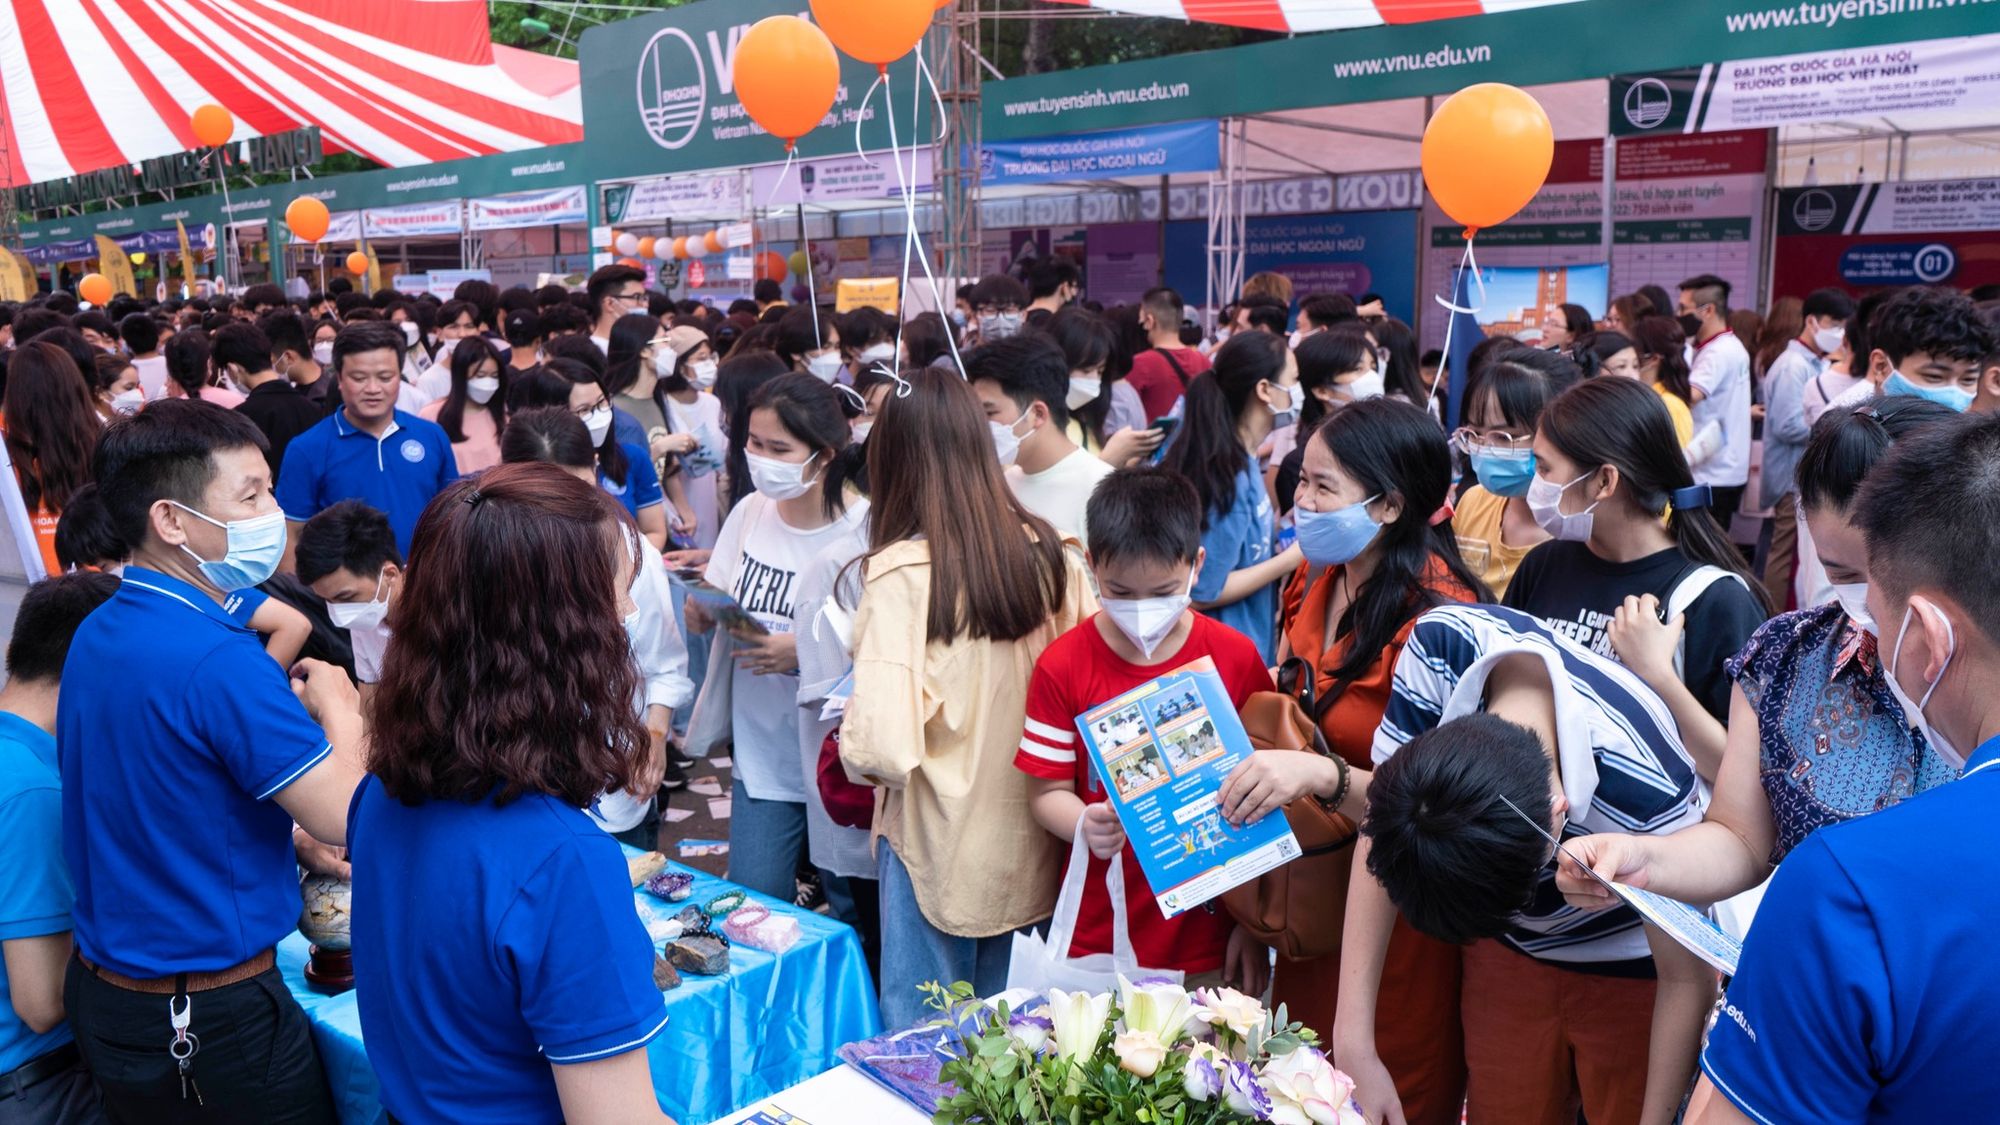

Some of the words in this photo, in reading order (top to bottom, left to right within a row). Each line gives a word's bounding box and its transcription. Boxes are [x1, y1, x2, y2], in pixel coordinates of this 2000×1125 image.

[1334, 44, 1491, 78] www.vnu.edu.vn
[1790, 59, 1828, 74] QUỐC
[1833, 57, 1855, 68] GIA
[1885, 50, 1912, 65] NỘI
[1850, 68, 1876, 81] VIỆT
[1004, 82, 1190, 117] www.tuyensinh.vnu.edu.vn
[712, 125, 749, 140] Vietnam
[1072, 156, 1096, 174] HỌC
[1098, 153, 1135, 170] NGOẠI
[1137, 148, 1167, 166] NGỮ
[1271, 242, 1295, 256] HỌC
[1298, 239, 1335, 253] NGOẠI
[1924, 254, 1942, 272] 01
[1577, 607, 1587, 624] I
